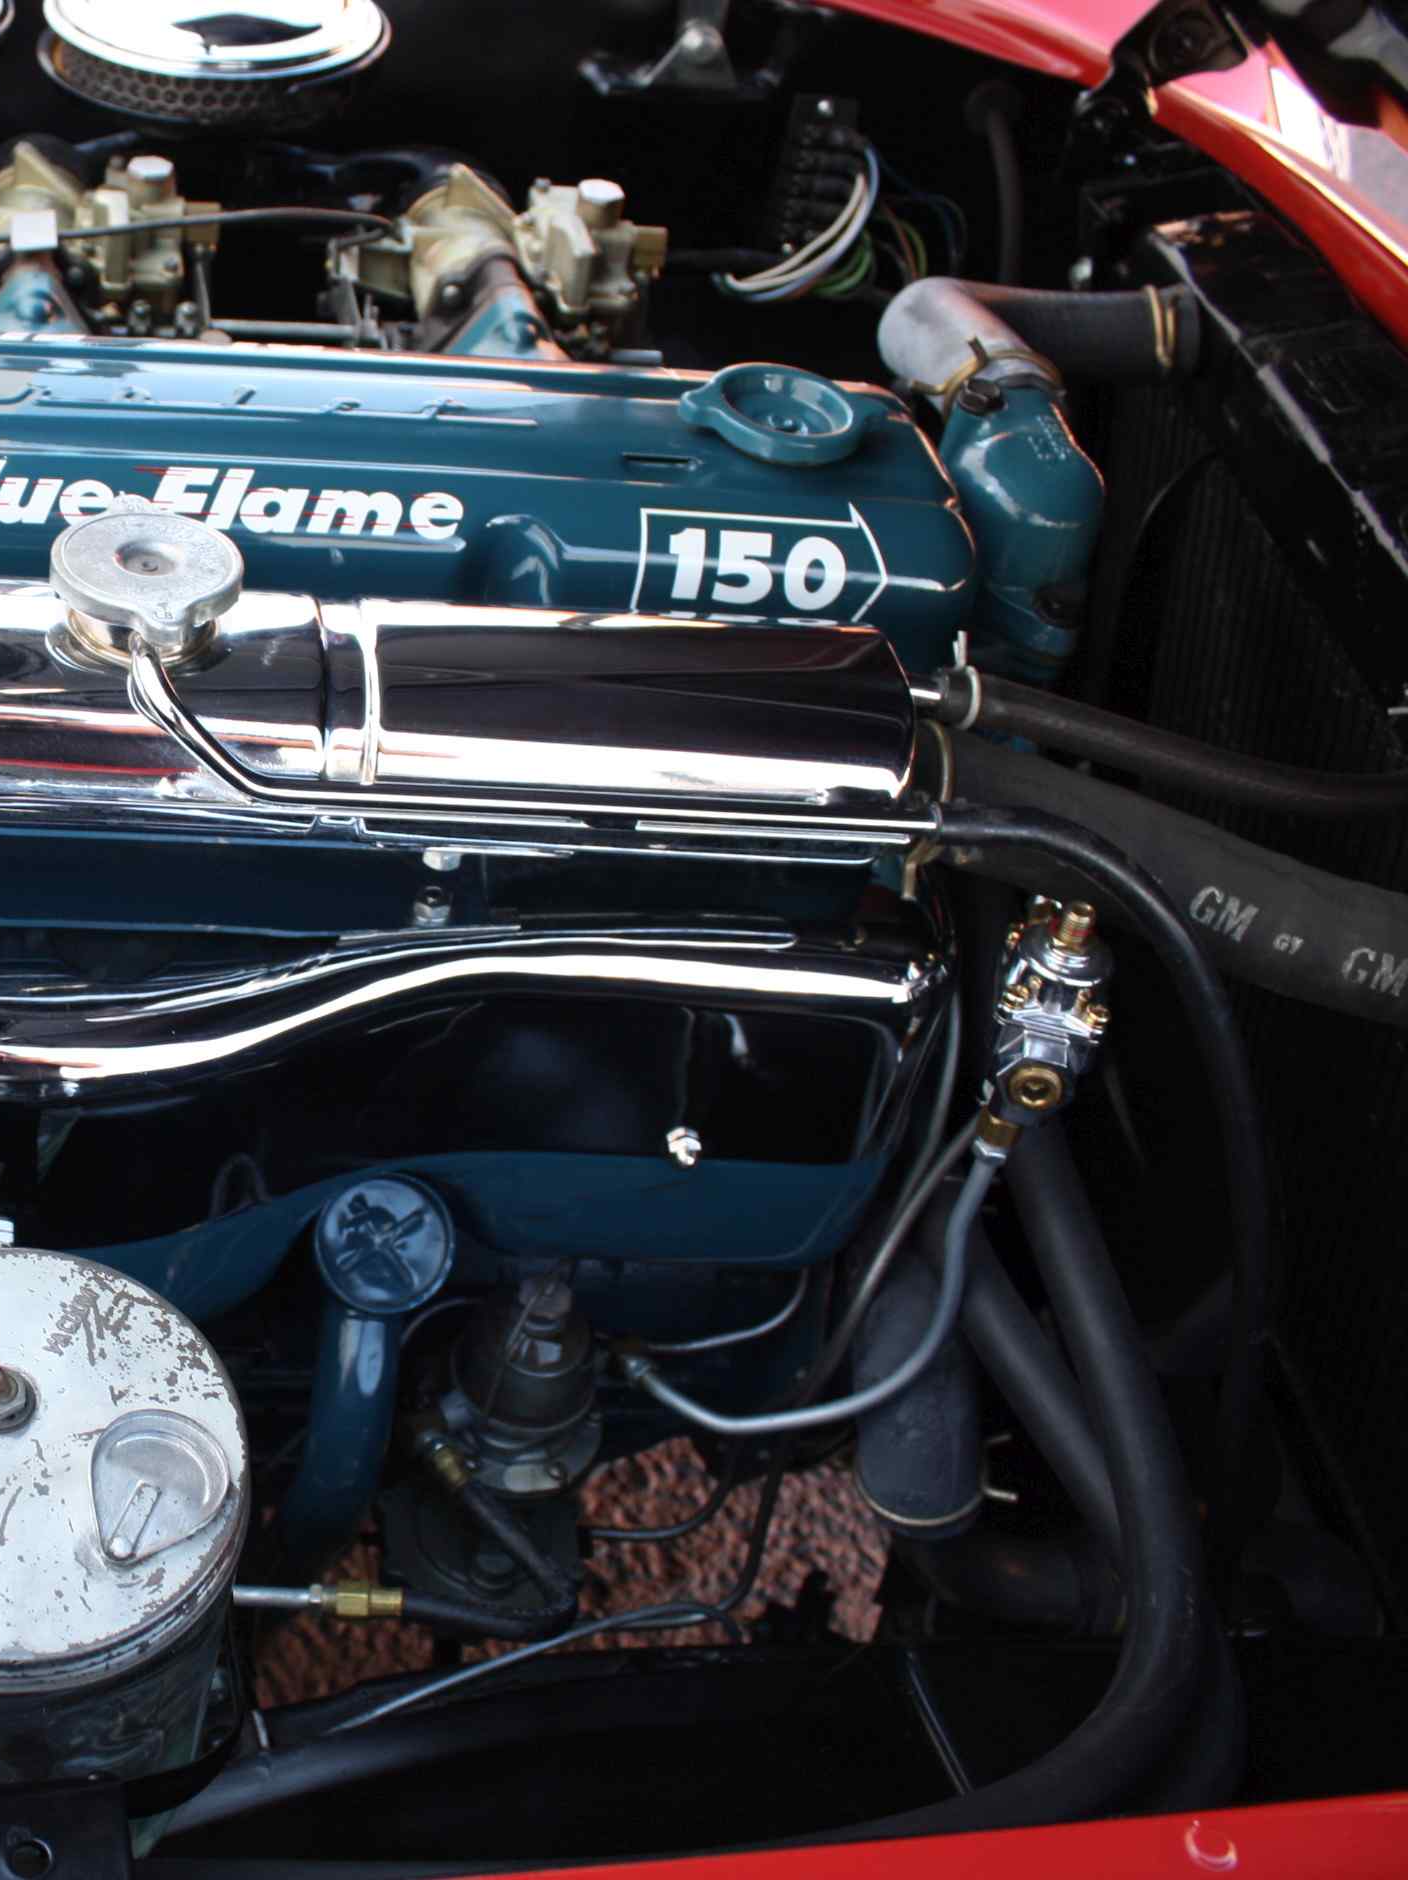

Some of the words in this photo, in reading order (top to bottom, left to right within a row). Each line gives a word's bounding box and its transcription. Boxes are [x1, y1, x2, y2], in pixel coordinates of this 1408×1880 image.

[152, 466, 465, 540] Flame
[669, 528, 846, 611] 150
[1190, 885, 1260, 943] GM
[1343, 948, 1408, 997] GM
